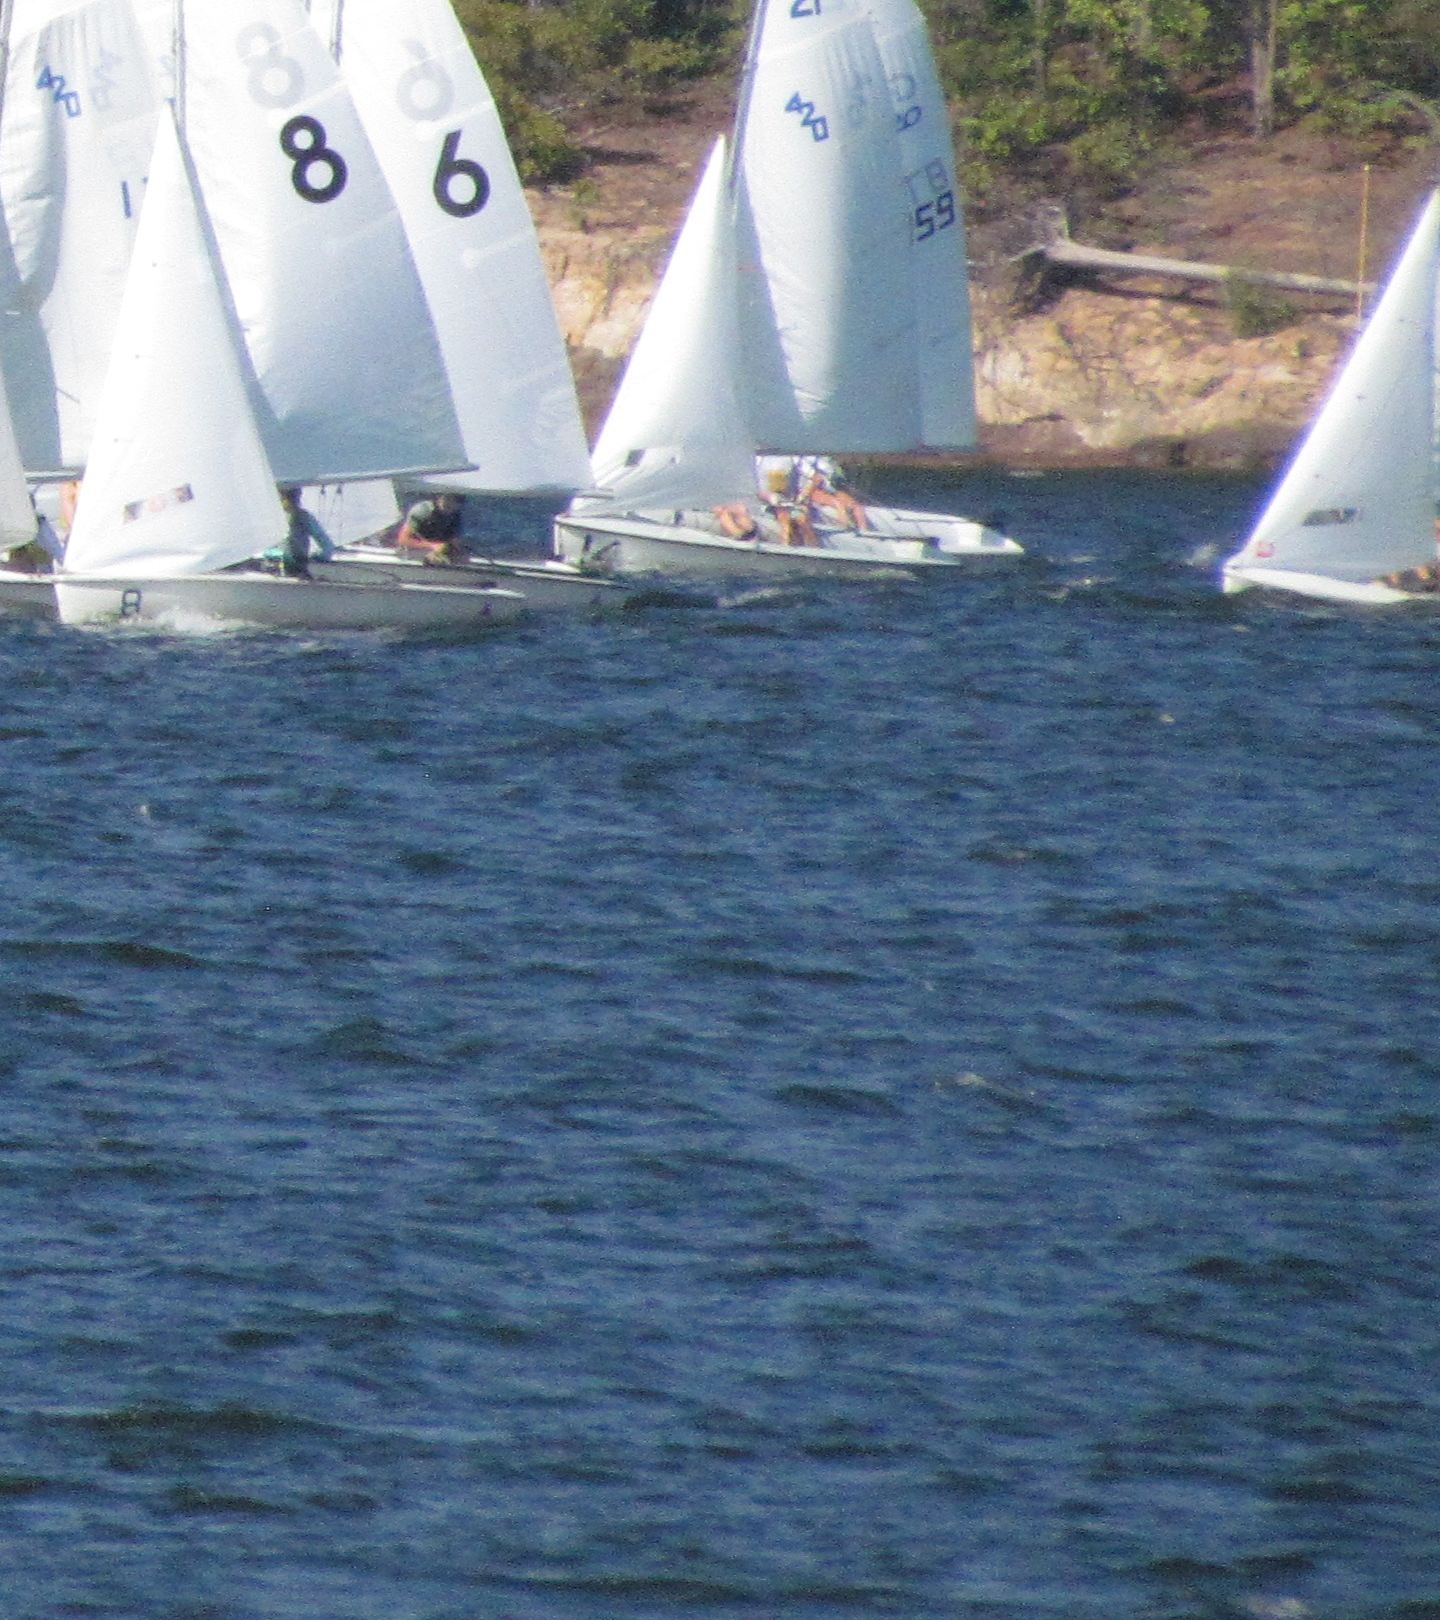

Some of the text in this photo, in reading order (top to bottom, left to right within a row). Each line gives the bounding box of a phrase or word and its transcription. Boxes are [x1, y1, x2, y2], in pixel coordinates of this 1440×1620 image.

[36, 65, 80, 117] 420
[785, 92, 830, 142] 420
[280, 115, 348, 204] 8
[433, 129, 489, 218] 6
